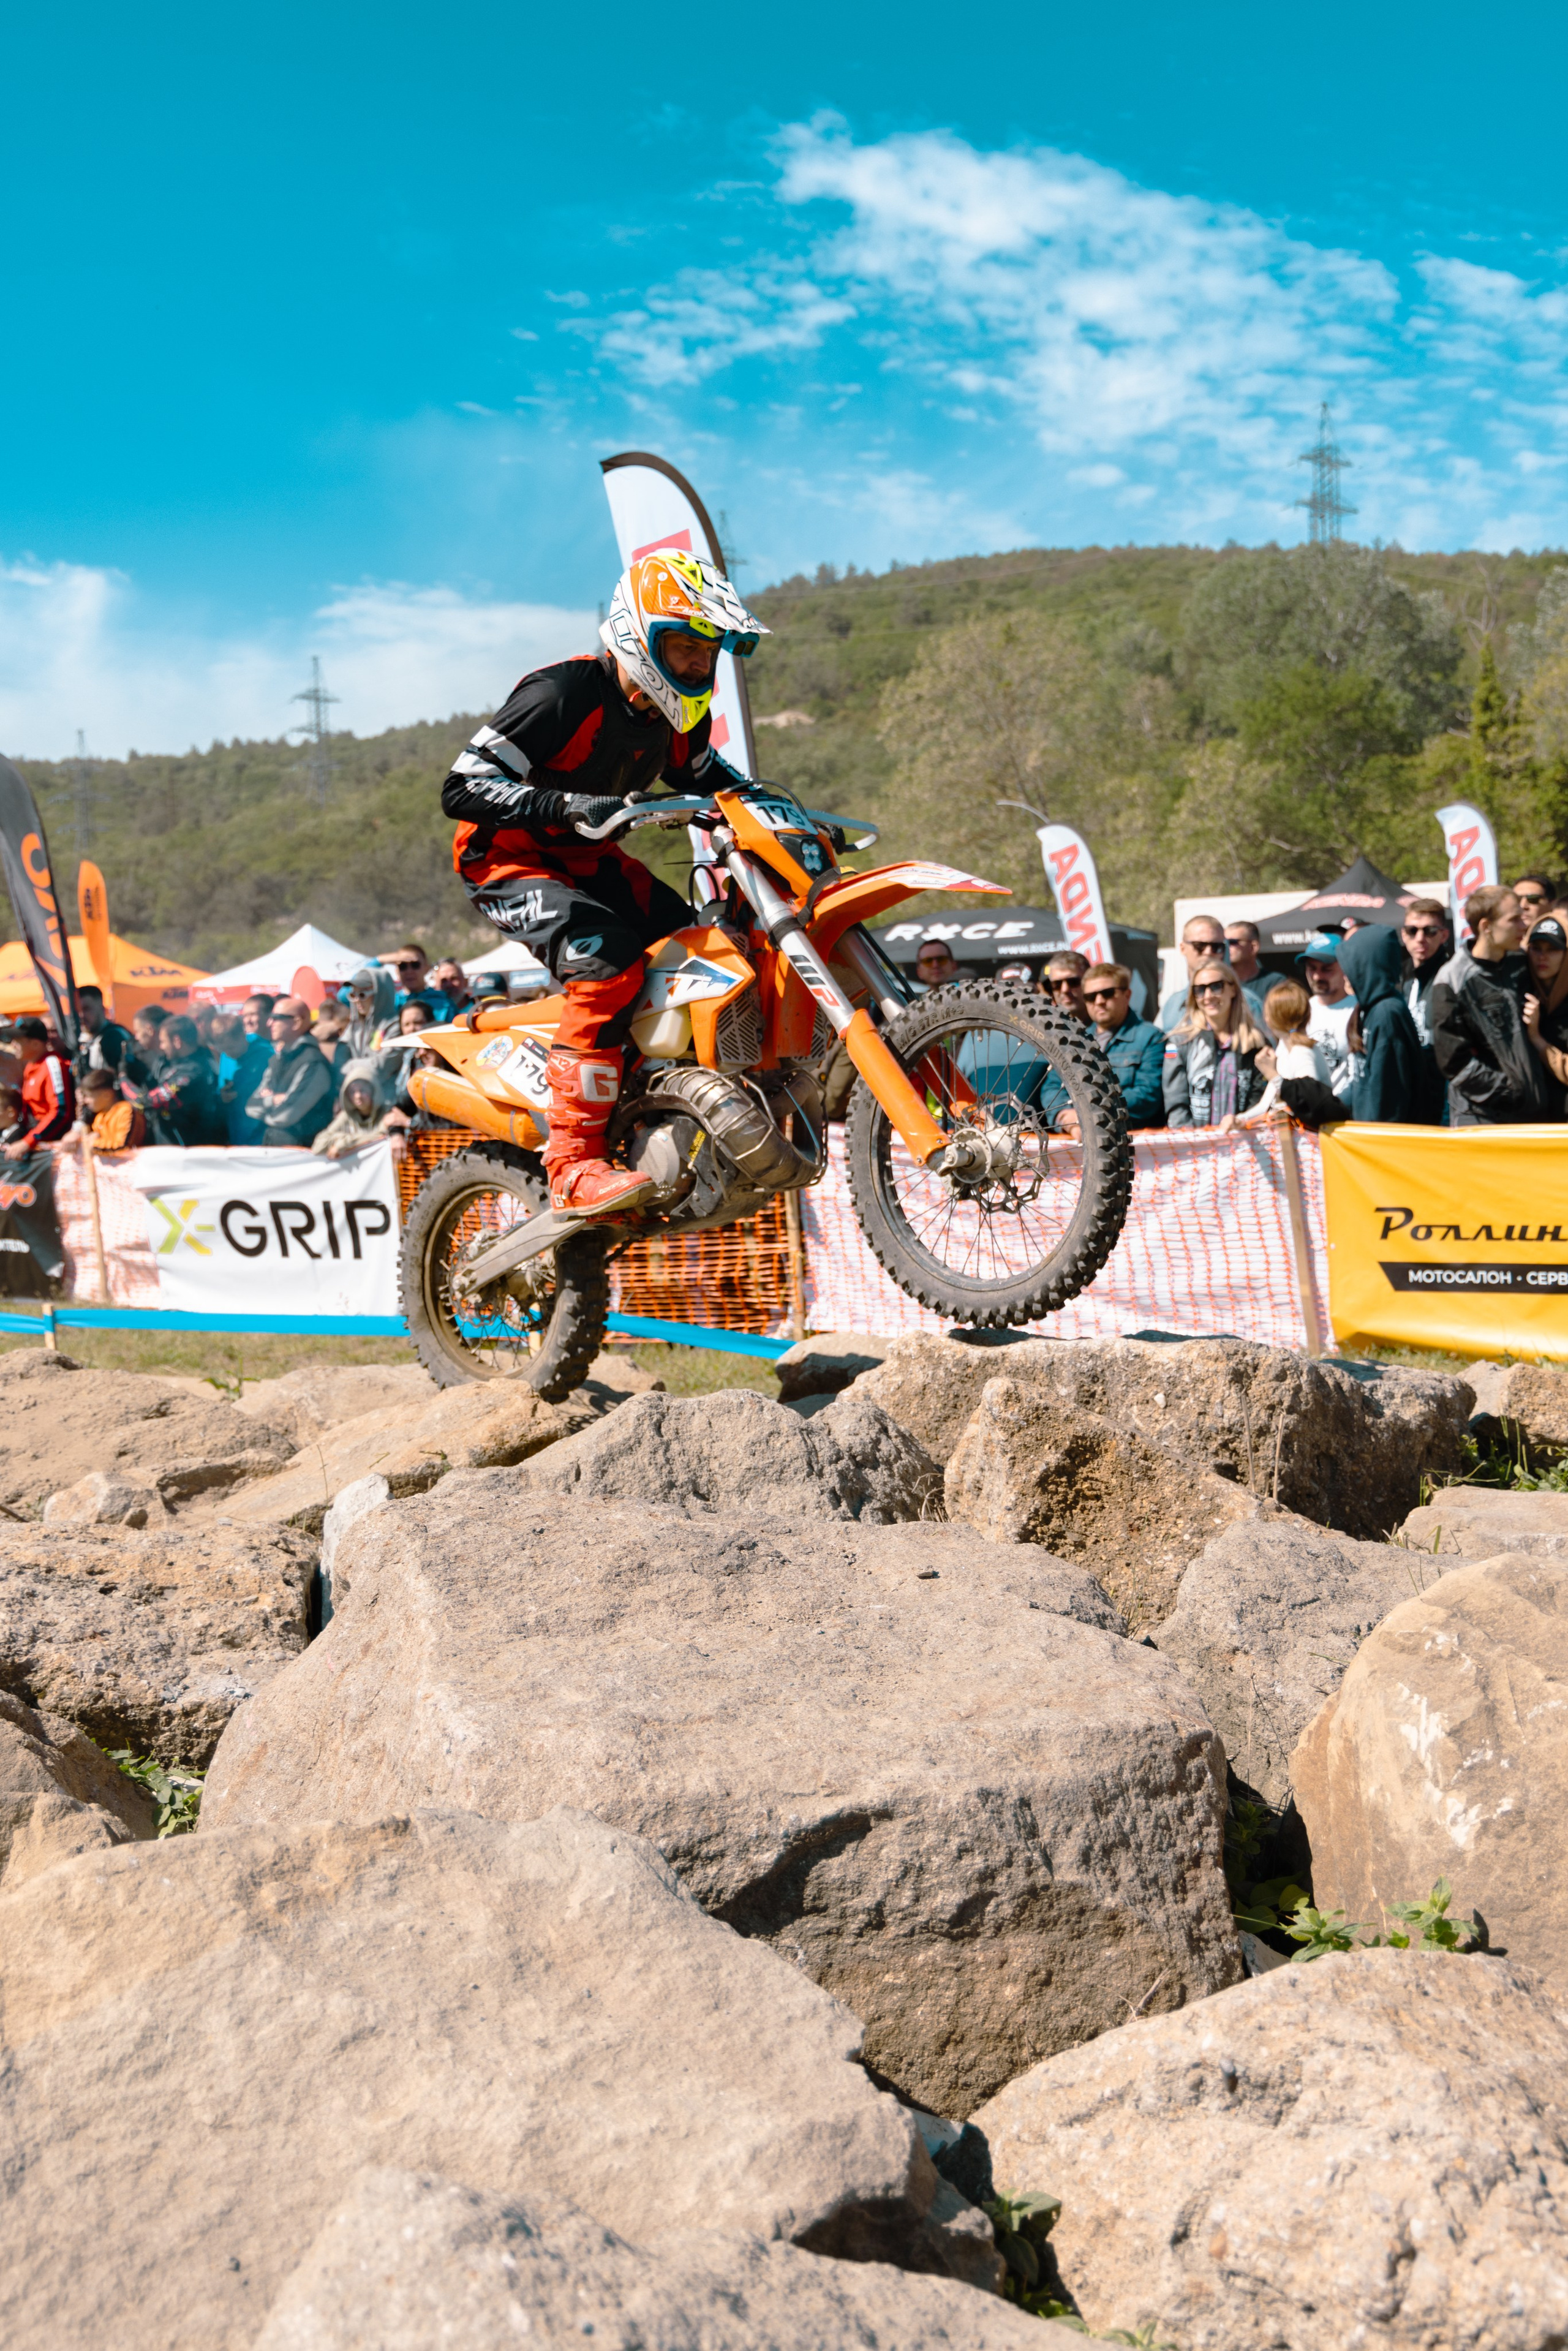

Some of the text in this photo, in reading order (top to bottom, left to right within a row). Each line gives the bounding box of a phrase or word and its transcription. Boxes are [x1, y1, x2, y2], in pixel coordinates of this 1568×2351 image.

[756, 805, 805, 826] 179
[512, 1055, 549, 1095] 179
[580, 1064, 619, 1103] G
[151, 1197, 391, 1259] X-GRIP
[1408, 1269, 1512, 1285] МОТОСАЛОН
